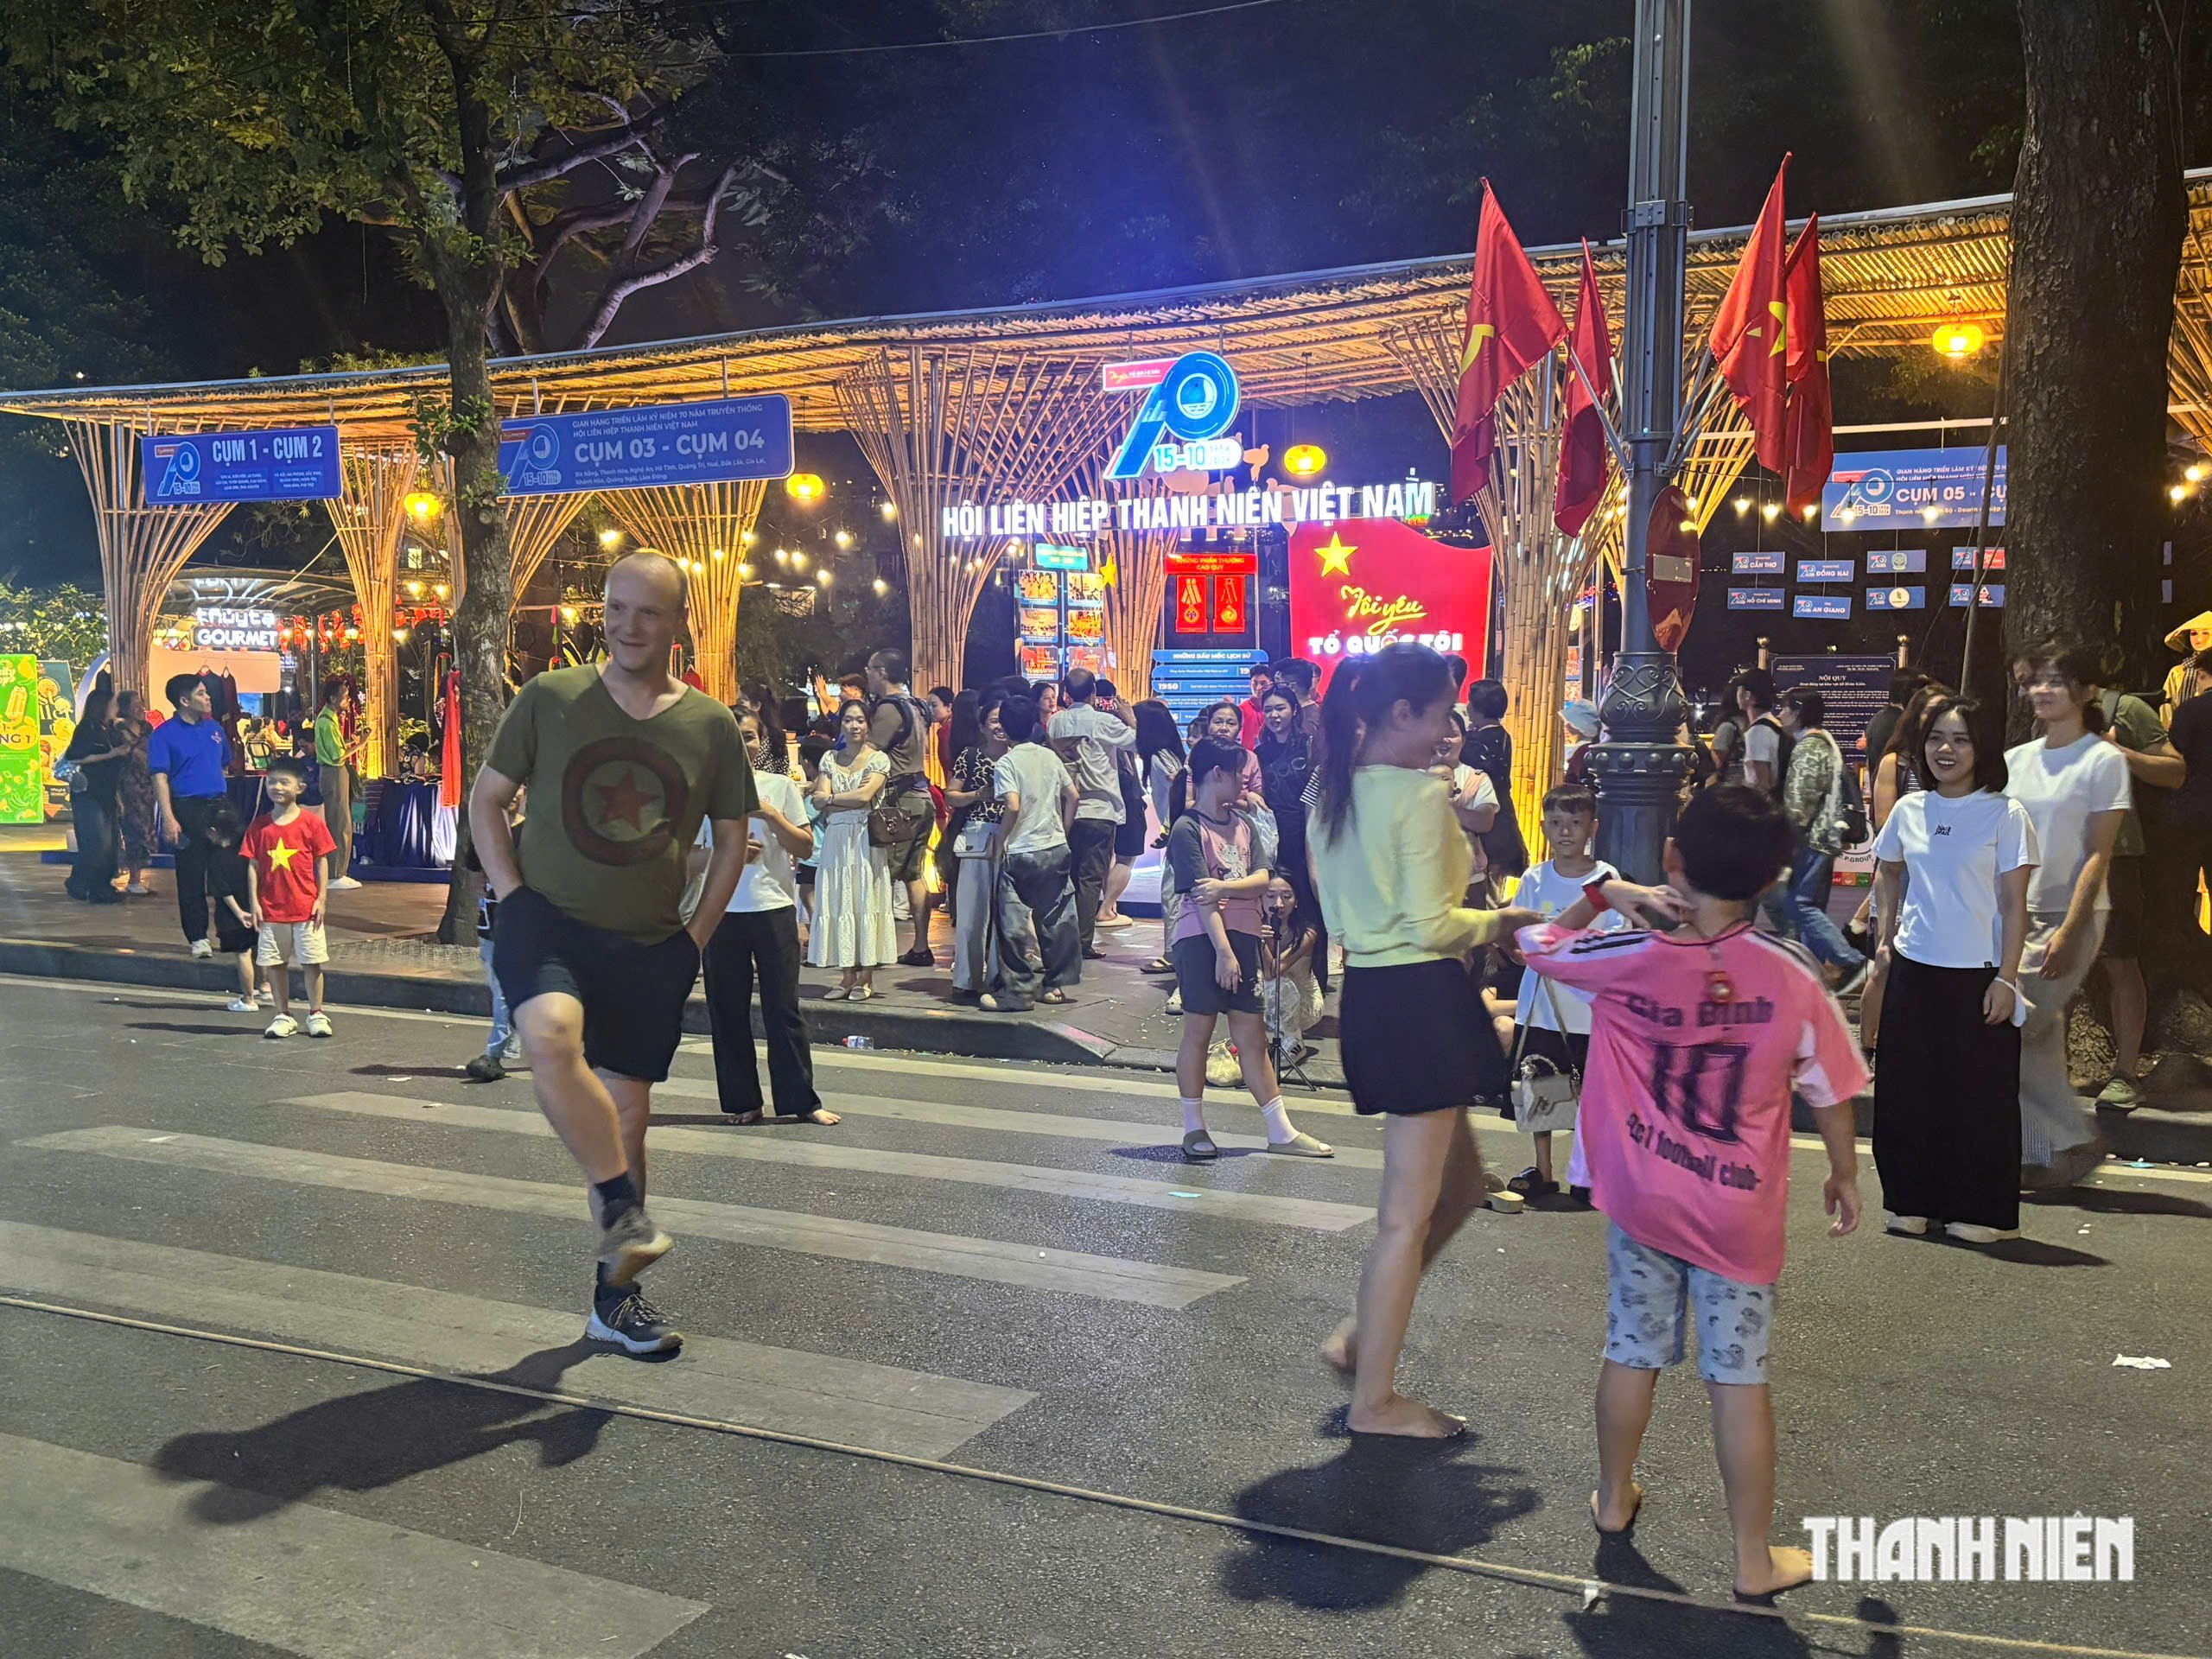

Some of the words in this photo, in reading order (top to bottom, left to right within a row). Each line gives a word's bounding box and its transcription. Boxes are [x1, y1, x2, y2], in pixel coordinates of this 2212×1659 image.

[590, 417, 610, 426] HÀNG
[620, 425, 645, 434] THANH
[681, 420, 698, 429] NAM
[213, 439, 245, 467] CỤM
[250, 438, 257, 461] 1
[273, 435, 308, 464] CỤM
[312, 435, 323, 457] 2
[575, 440, 622, 467] CỤM
[629, 437, 656, 459] 03
[676, 431, 728, 460] CỤM
[734, 429, 765, 450] 04
[1155, 445, 1205, 469] 15-10
[1896, 486, 1938, 506] CỤM
[1942, 486, 1965, 499] 05
[943, 499, 984, 542] HỘI
[990, 498, 1046, 536] LIÊN
[1052, 496, 1109, 537] HIỆP
[1117, 493, 1208, 530] THANH
[1216, 485, 1282, 525] NIÊN
[1291, 480, 1354, 526] VIỆT
[1362, 480, 1435, 518] NAM
[197, 628, 277, 646] GOURMET
[1308, 629, 1341, 655] TỔ
[1418, 630, 1463, 652] TÔI
[1651, 1041, 1751, 1145] 10
